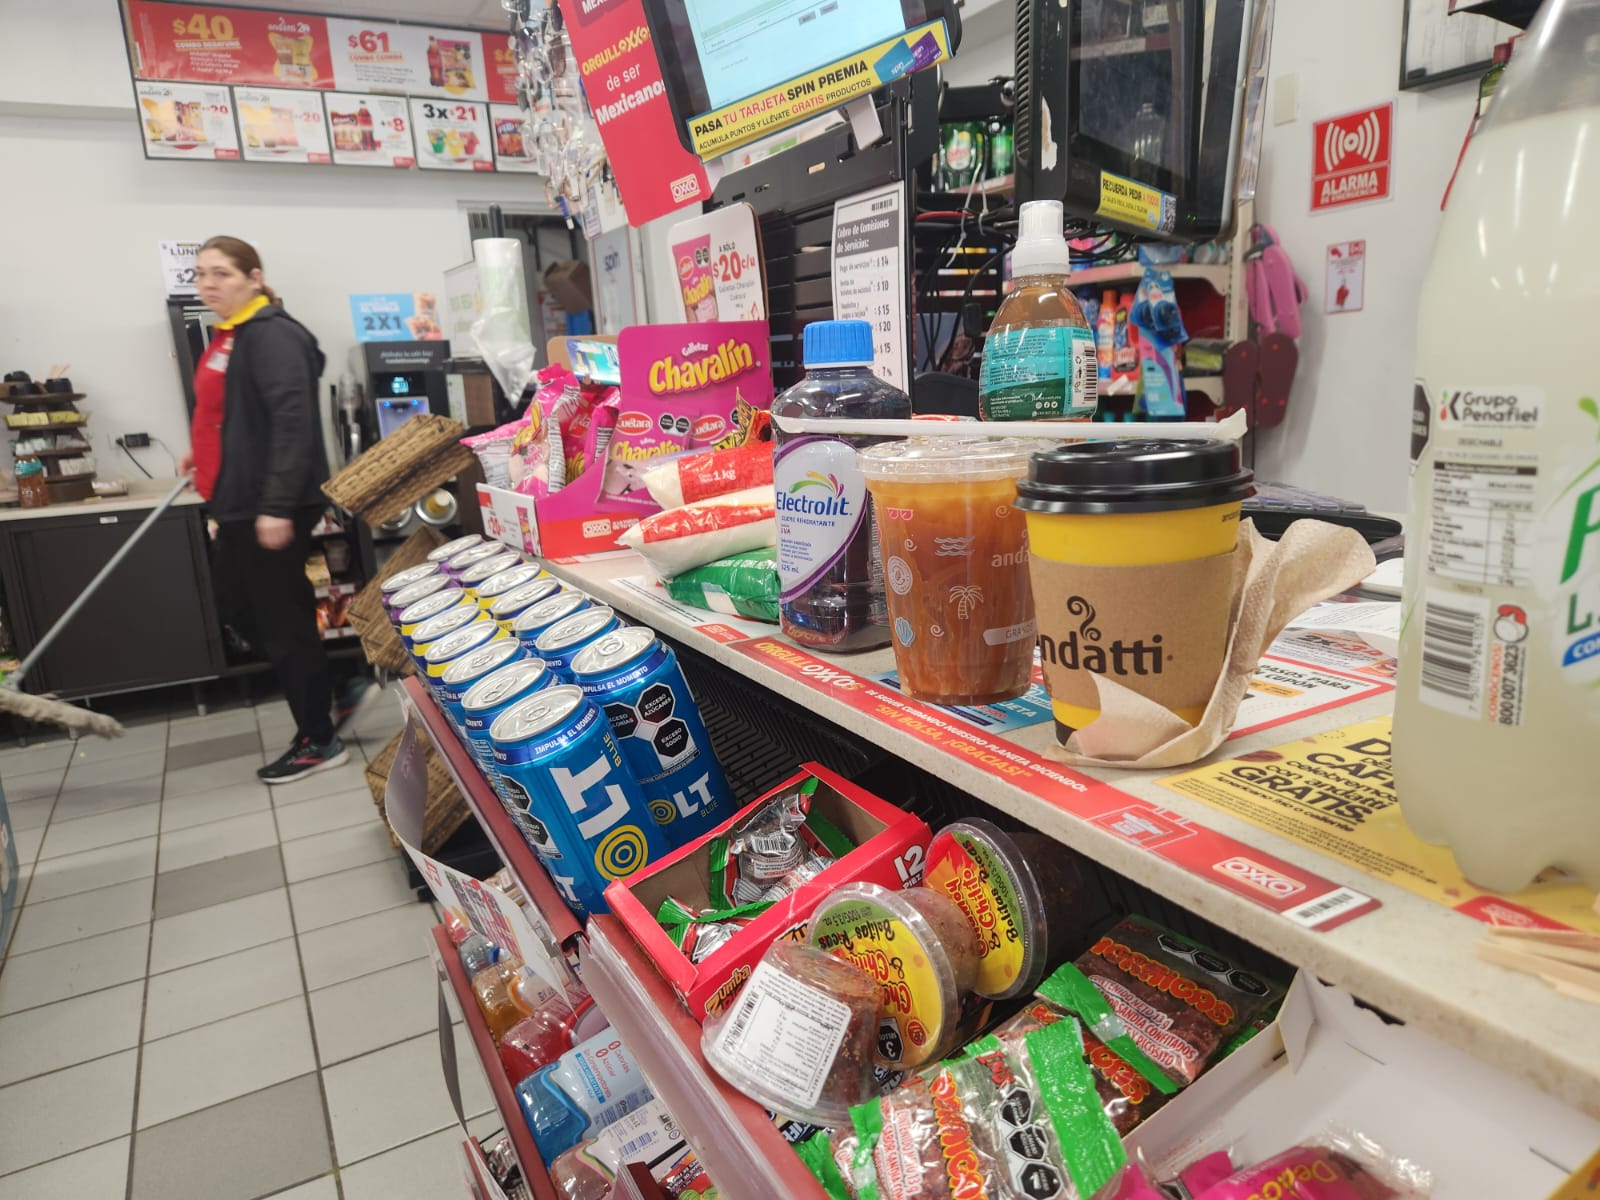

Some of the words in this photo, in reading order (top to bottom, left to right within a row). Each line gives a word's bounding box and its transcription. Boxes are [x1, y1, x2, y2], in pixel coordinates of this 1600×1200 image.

[172, 13, 234, 41] $40
[347, 30, 390, 53] $61
[606, 73, 622, 92] de
[622, 62, 641, 84] ser
[423, 103, 449, 119] 3x
[694, 117, 723, 137] PASA
[722, 112, 738, 126] TU
[738, 92, 787, 119] TARJETA
[786, 79, 816, 101] SPIN
[817, 60, 869, 89] PREMIA
[699, 133, 730, 151] ACUMULA
[729, 122, 757, 138] PUNTOS
[761, 108, 790, 127] LLÉVATE
[790, 94, 825, 114] GRATIS
[825, 78, 872, 101] PRODUCTOS
[671, 176, 700, 199] OXXO
[1321, 170, 1378, 198] ALARMA
[837, 226, 852, 239] Cobro
[852, 224, 859, 235] de
[859, 218, 890, 235] Comisiones
[836, 242, 844, 254] de
[844, 238, 869, 253] Servicios:
[712, 250, 742, 283] $20
[741, 253, 756, 270] c/u
[681, 342, 709, 357] Galletas
[649, 338, 753, 393] Chavalín
[1462, 391, 1518, 410] Grupo
[713, 470, 721, 480] 1
[721, 469, 737, 481] kg
[776, 491, 850, 516] Electrolit
[1037, 630, 1163, 676] ndatti
[606, 681, 616, 691] EL
[616, 665, 649, 687] MOMENTO
[1260, 664, 1306, 679] PASOS
[1308, 677, 1352, 690] PARA
[644, 693, 668, 710] EXCESO
[754, 641, 865, 692] ORGULLOXXOS
[902, 705, 947, 727] CUIDANDO
[944, 724, 989, 746] NUESTRO
[986, 743, 1031, 766] PLANETA
[1028, 763, 1088, 792] DICIENDO:
[534, 734, 569, 755] IMPULSA
[567, 728, 577, 737] EL
[602, 731, 622, 768] BLUE
[661, 727, 683, 744] EXCESO
[665, 735, 683, 749] SODIO
[1231, 766, 1373, 824] GRATIS.
[1265, 765, 1302, 780] con
[1304, 775, 1393, 810] andatti
[1286, 760, 1398, 803] celebremos
[700, 800, 719, 818] BLUE
[1215, 776, 1272, 801] Americano
[1303, 809, 1355, 833] caliente
[893, 845, 925, 883] 12
[962, 839, 990, 884] Ricas
[1222, 858, 1294, 898] OXXO
[962, 867, 996, 930] Chilito
[855, 918, 895, 942] Bolitas
[991, 888, 1019, 944] Bolitas
[818, 930, 854, 951] Ricas
[888, 956, 905, 980] &
[705, 965, 751, 1014] Zumba
[883, 980, 912, 1014] Cha
[1131, 999, 1155, 1017] NETO
[1153, 1012, 1166, 1025] 13
[1160, 1019, 1171, 1031] g
[595, 1048, 609, 1058] 0
[607, 1040, 622, 1051] 0
[884, 1041, 896, 1058] 3
[1136, 1036, 1174, 1066] PICOSITO
[1144, 1023, 1196, 1060] CONFITADOS
